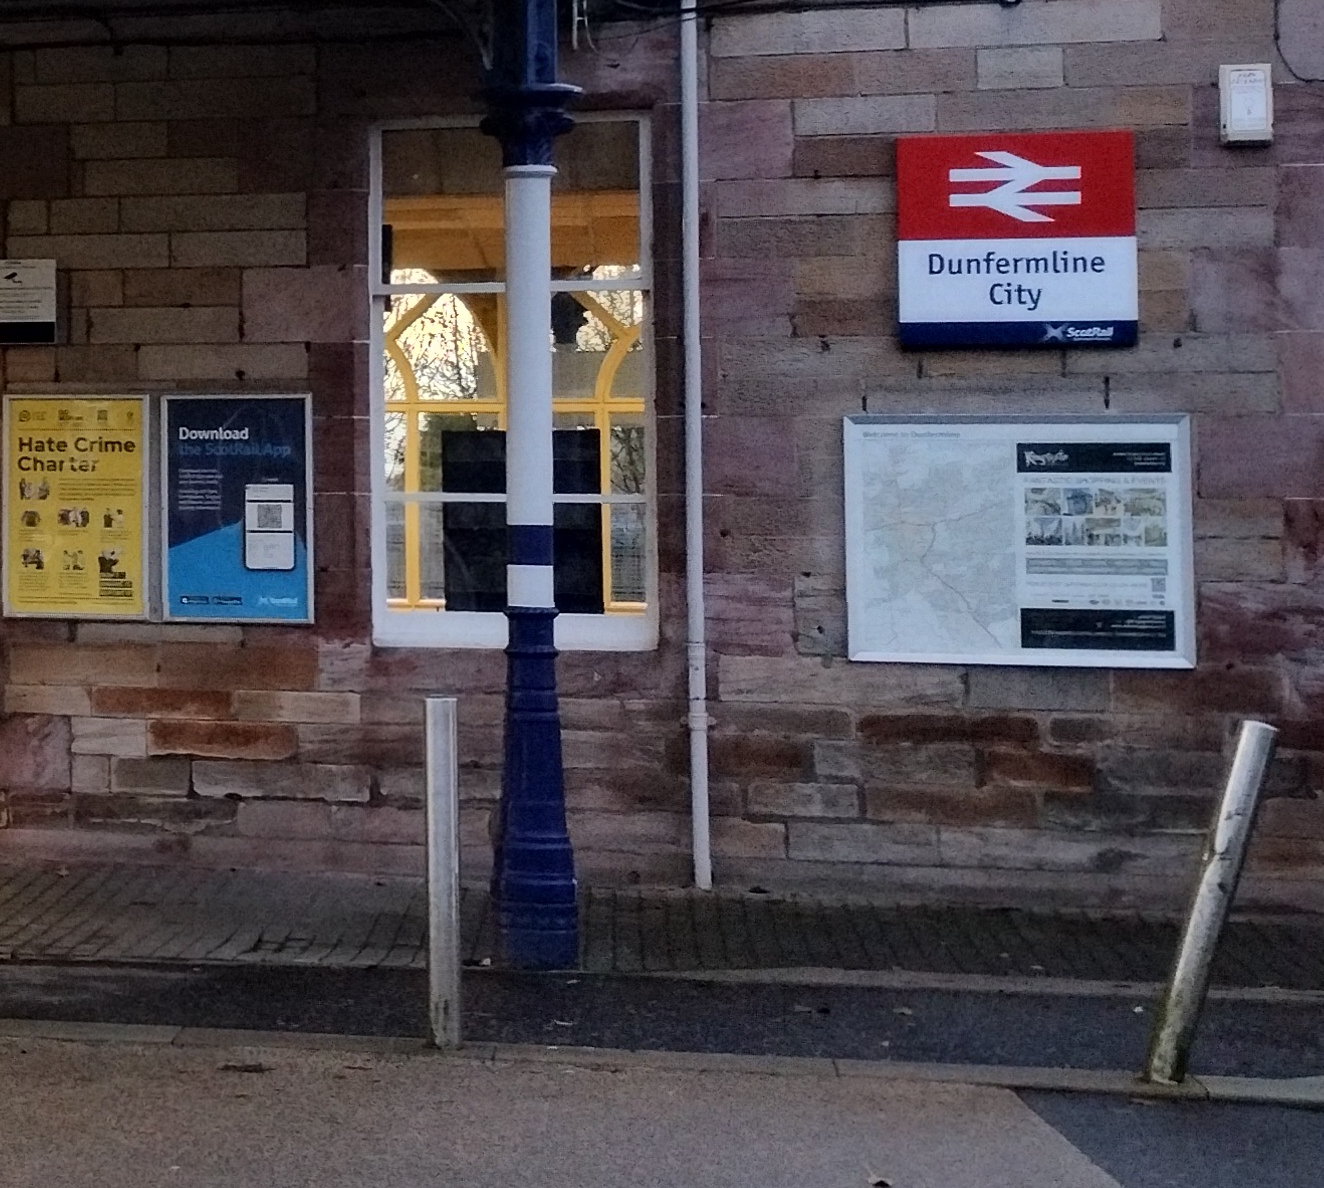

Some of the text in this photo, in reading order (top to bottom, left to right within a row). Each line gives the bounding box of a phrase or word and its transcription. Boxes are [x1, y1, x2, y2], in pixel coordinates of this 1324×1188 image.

[928, 251, 1106, 275] Dunfermline
[989, 283, 1043, 311] City
[1067, 326, 1114, 338] ScotRail
[179, 426, 249, 440] Download
[18, 436, 136, 452] Hate Crime
[180, 442, 292, 458] the ScotRail App
[17, 455, 99, 472] Charter
